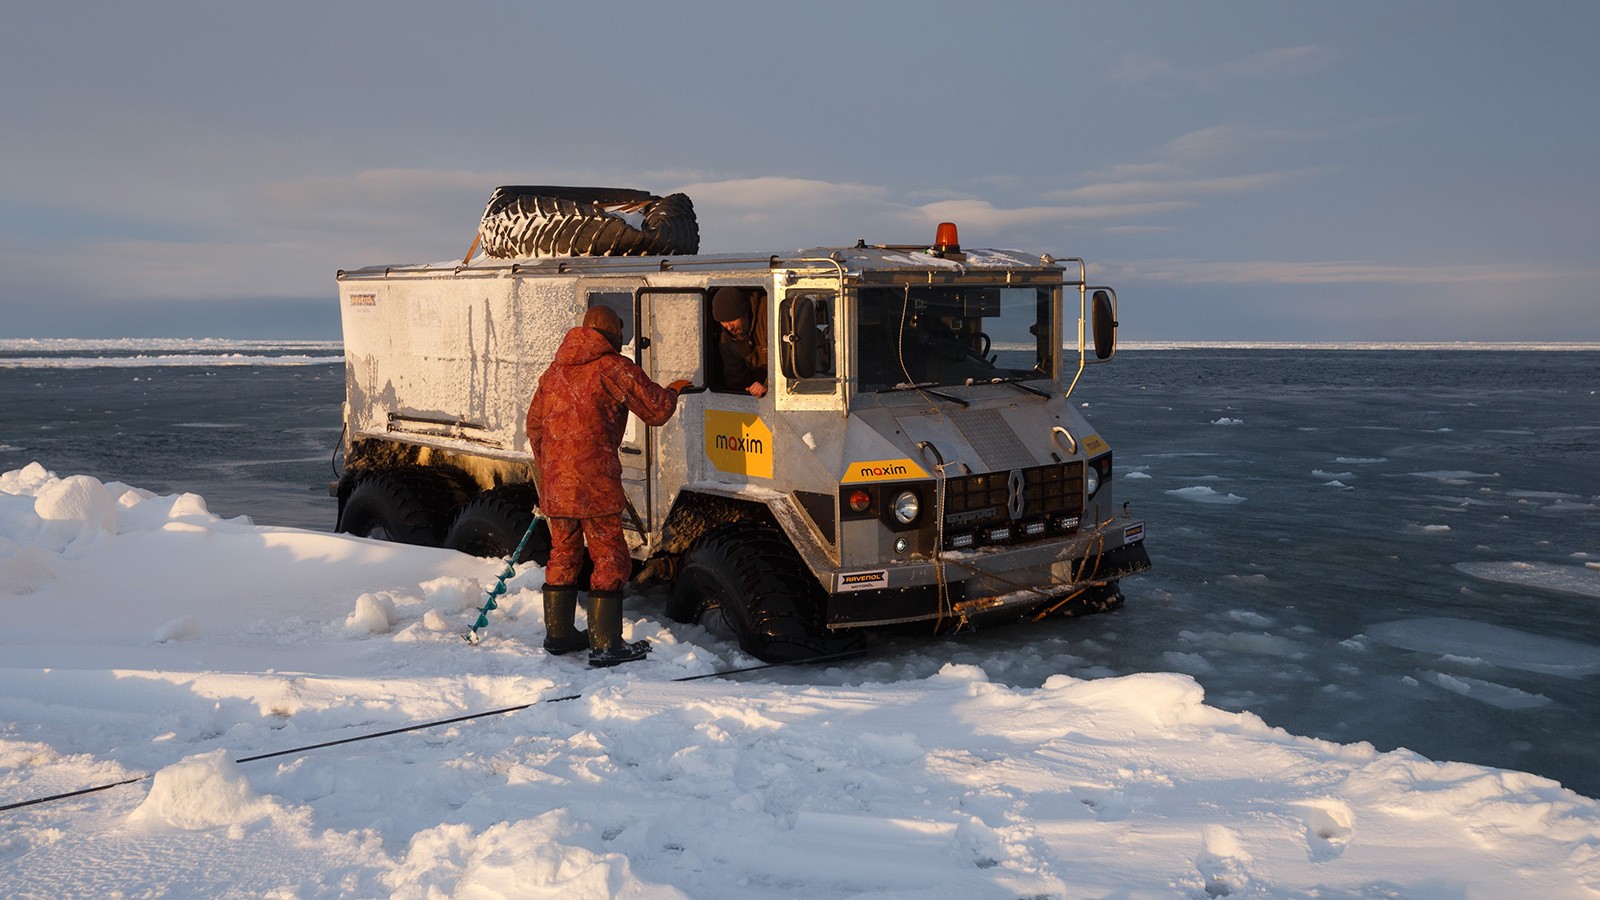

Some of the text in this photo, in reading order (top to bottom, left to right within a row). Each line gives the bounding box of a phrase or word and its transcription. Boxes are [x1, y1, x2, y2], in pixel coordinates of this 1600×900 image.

[715, 433, 763, 454] maxim
[860, 464, 907, 477] maxim
[845, 574, 881, 583] RAVENOL
